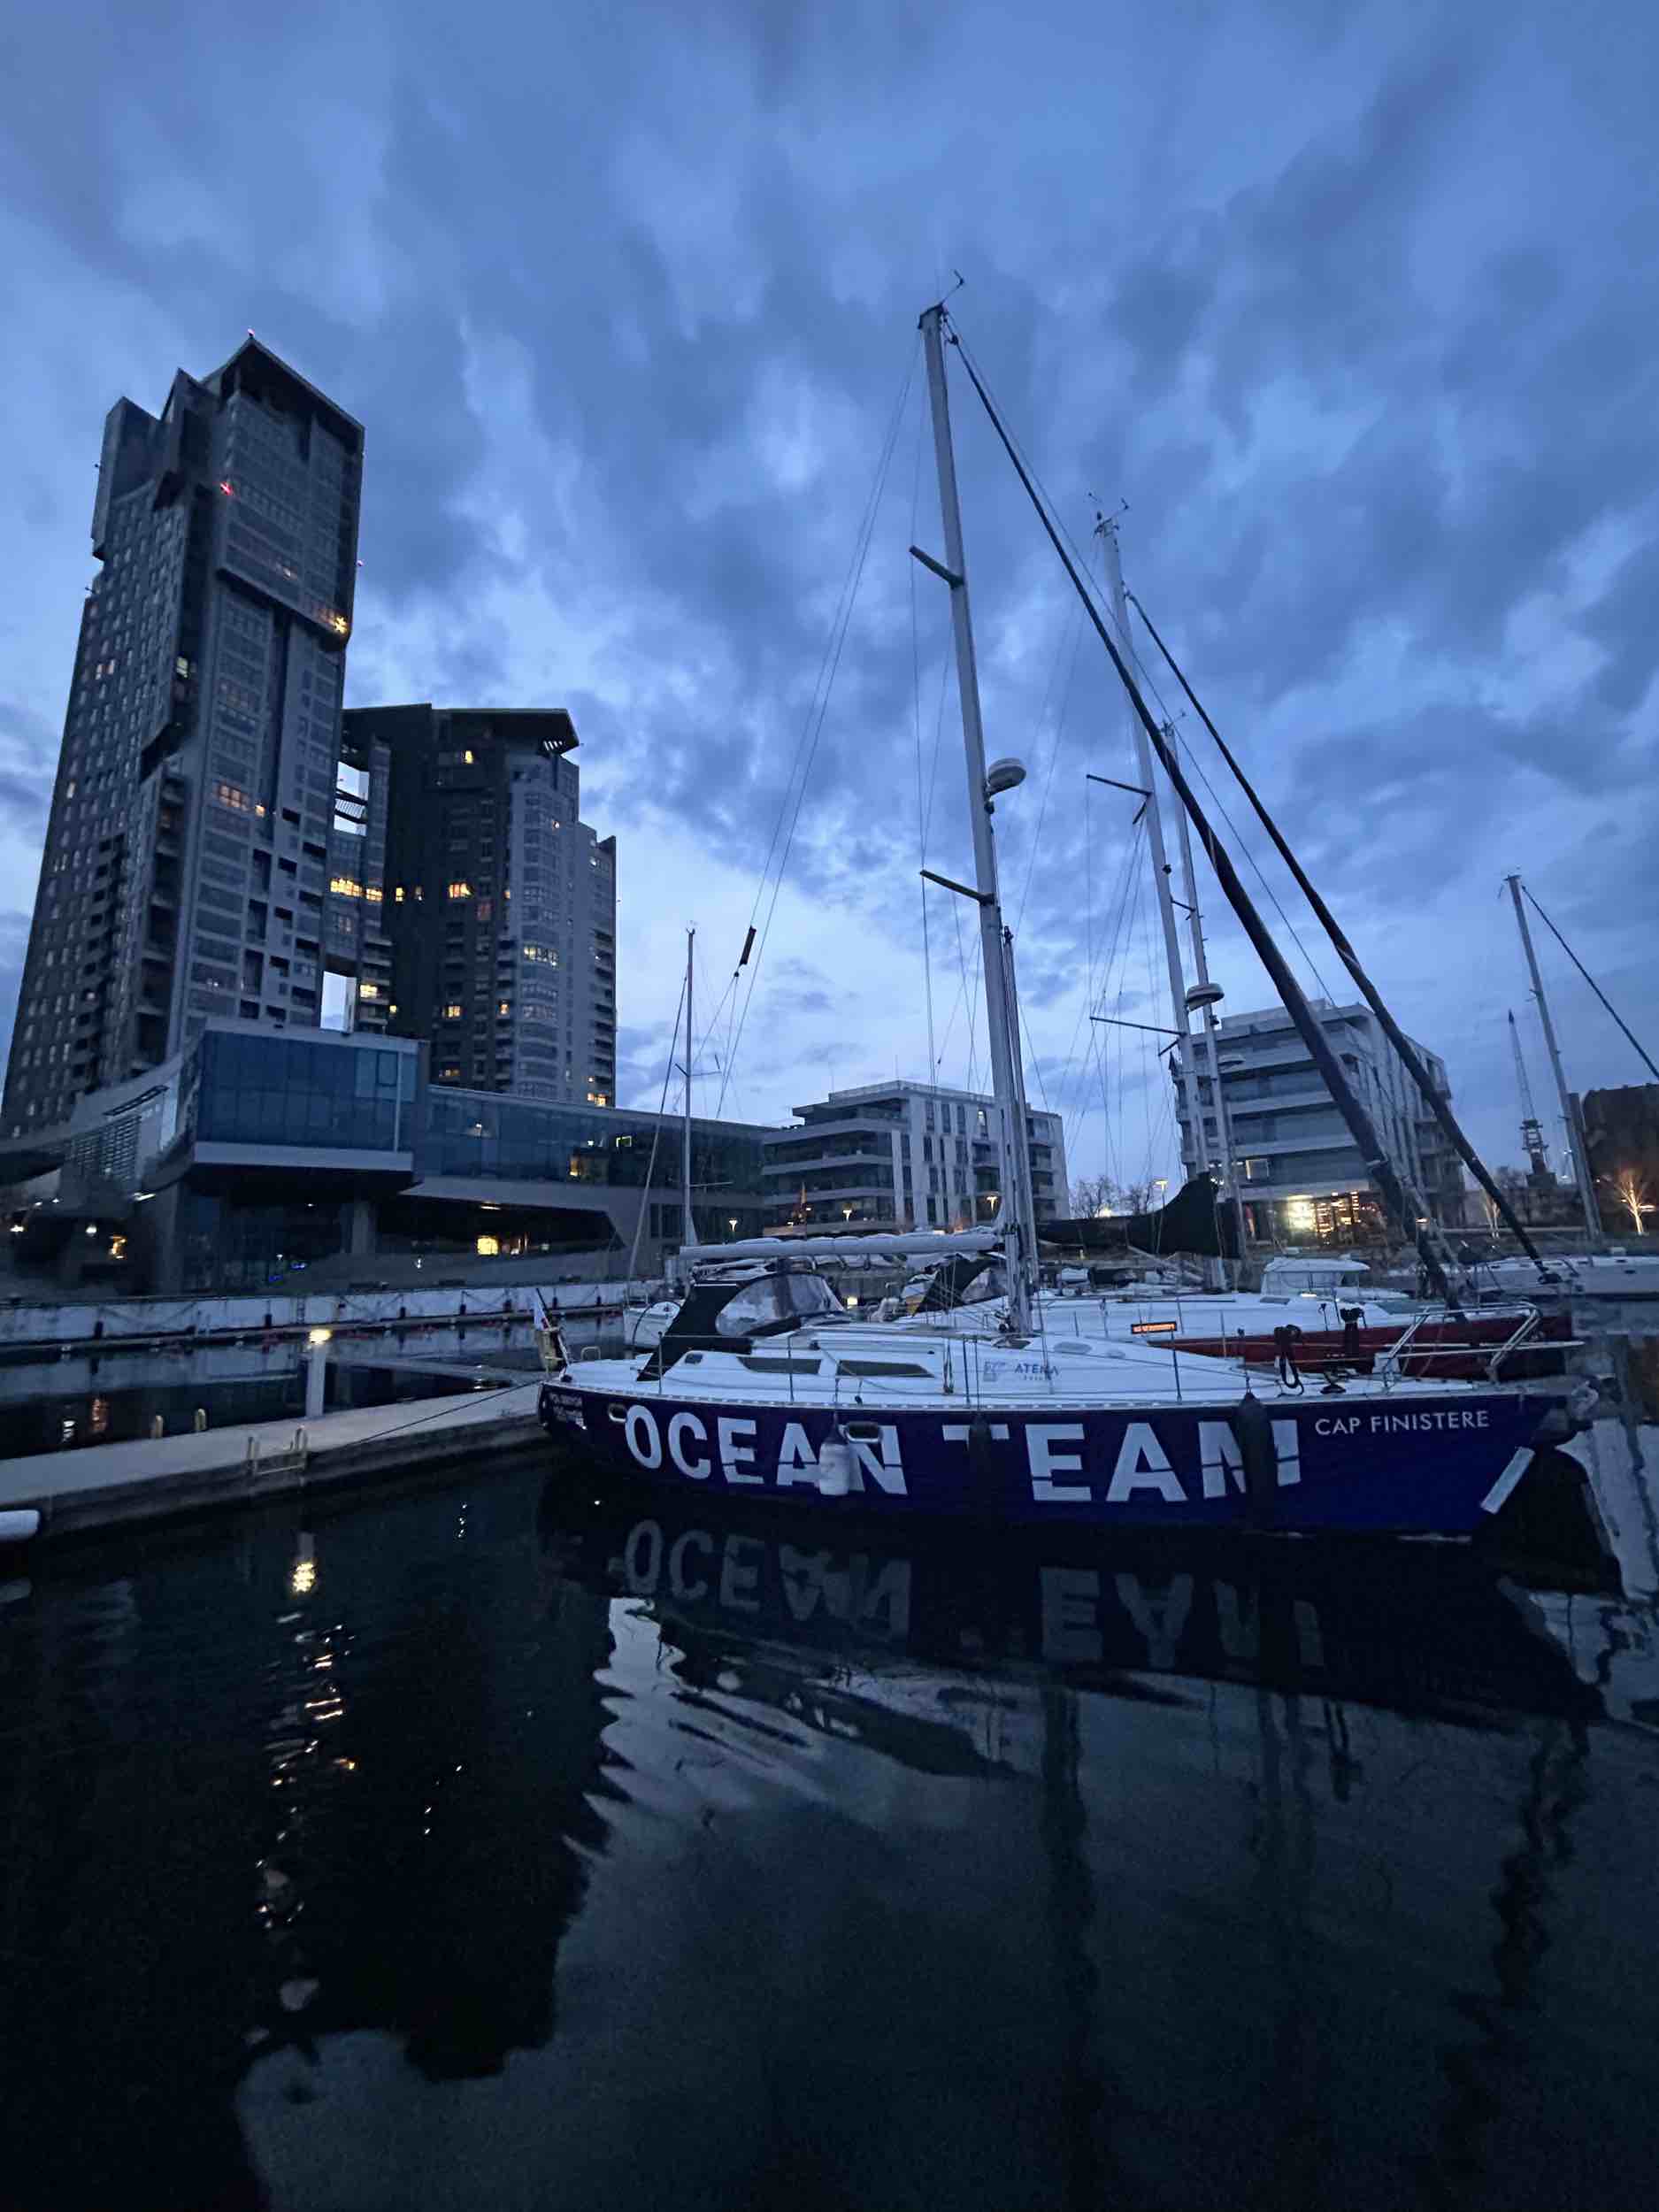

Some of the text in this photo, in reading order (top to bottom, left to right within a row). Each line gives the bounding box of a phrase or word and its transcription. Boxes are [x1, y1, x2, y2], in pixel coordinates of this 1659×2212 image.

[624, 1404, 909, 1495] OCEAN
[1314, 1409, 1490, 1435] CAP FINISTERE
